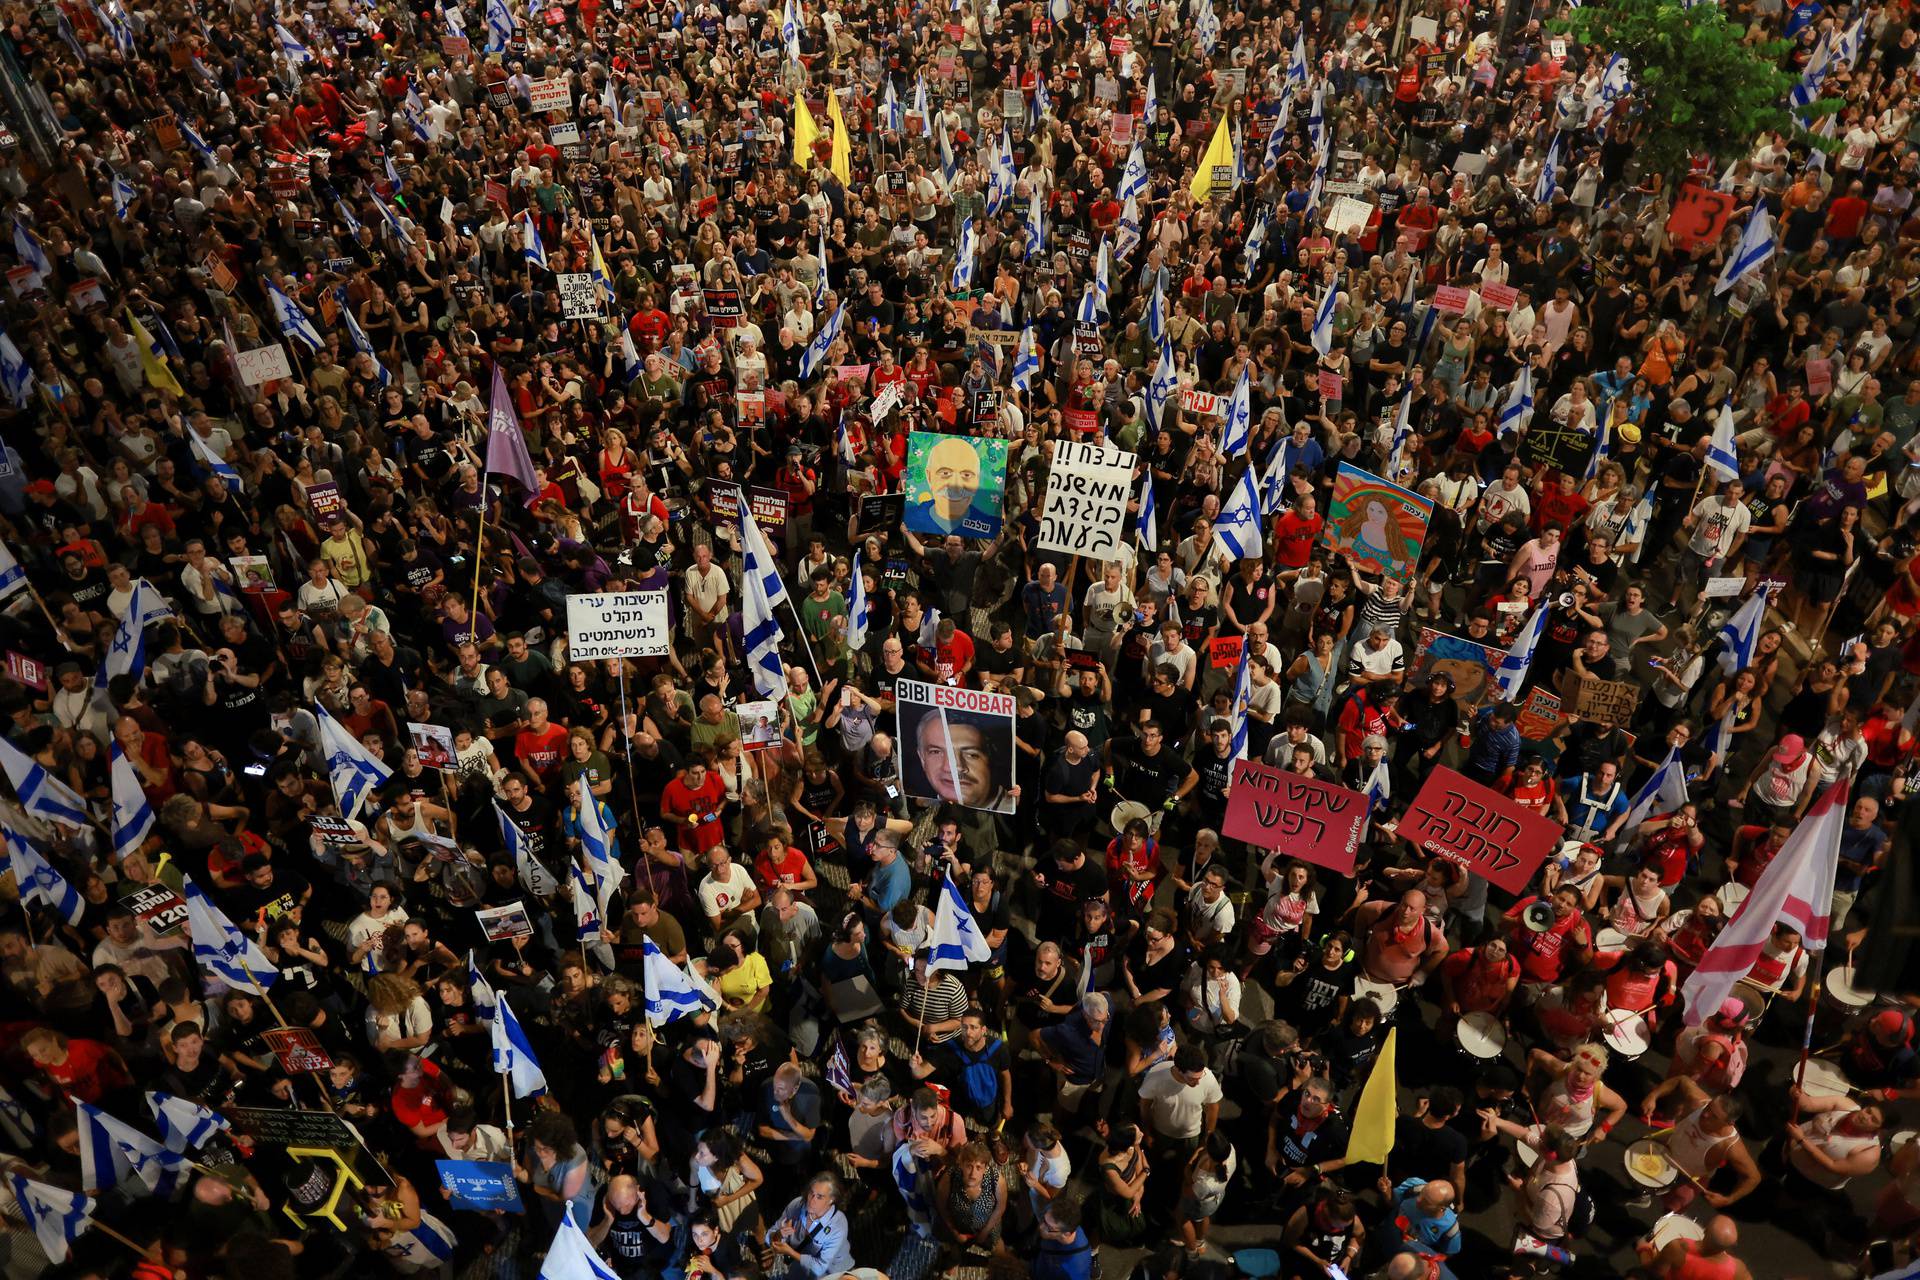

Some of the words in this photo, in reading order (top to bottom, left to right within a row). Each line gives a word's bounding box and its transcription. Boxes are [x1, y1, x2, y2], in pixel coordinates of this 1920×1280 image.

[1050, 471, 1126, 502] ממשלה
[753, 494, 786, 506] המלחמה
[753, 502, 786, 518] רעה
[1048, 501, 1122, 526] בוגדת
[964, 518, 990, 533] שלמה
[1038, 516, 1114, 553] בעמה
[580, 597, 604, 608] ערי
[602, 610, 643, 624] מקלט
[579, 626, 656, 642] למשתמטים
[572, 646, 599, 658] חובה
[898, 680, 930, 703] BIBI
[934, 687, 1014, 715] ESCOBAR
[1614, 682, 1636, 698] אין
[1592, 692, 1631, 707] גדולה
[1239, 768, 1281, 794] הוא
[1287, 781, 1350, 814] שקט
[310, 820, 350, 831] עסקה
[315, 816, 335, 824] רק
[1254, 800, 1328, 843] רפש
[1443, 790, 1522, 845] חובה
[322, 832, 358, 843] 120
[1415, 806, 1521, 873] להתנגד
[132, 890, 175, 914] עסקה
[133, 888, 156, 902] רק
[148, 904, 189, 928] 120
